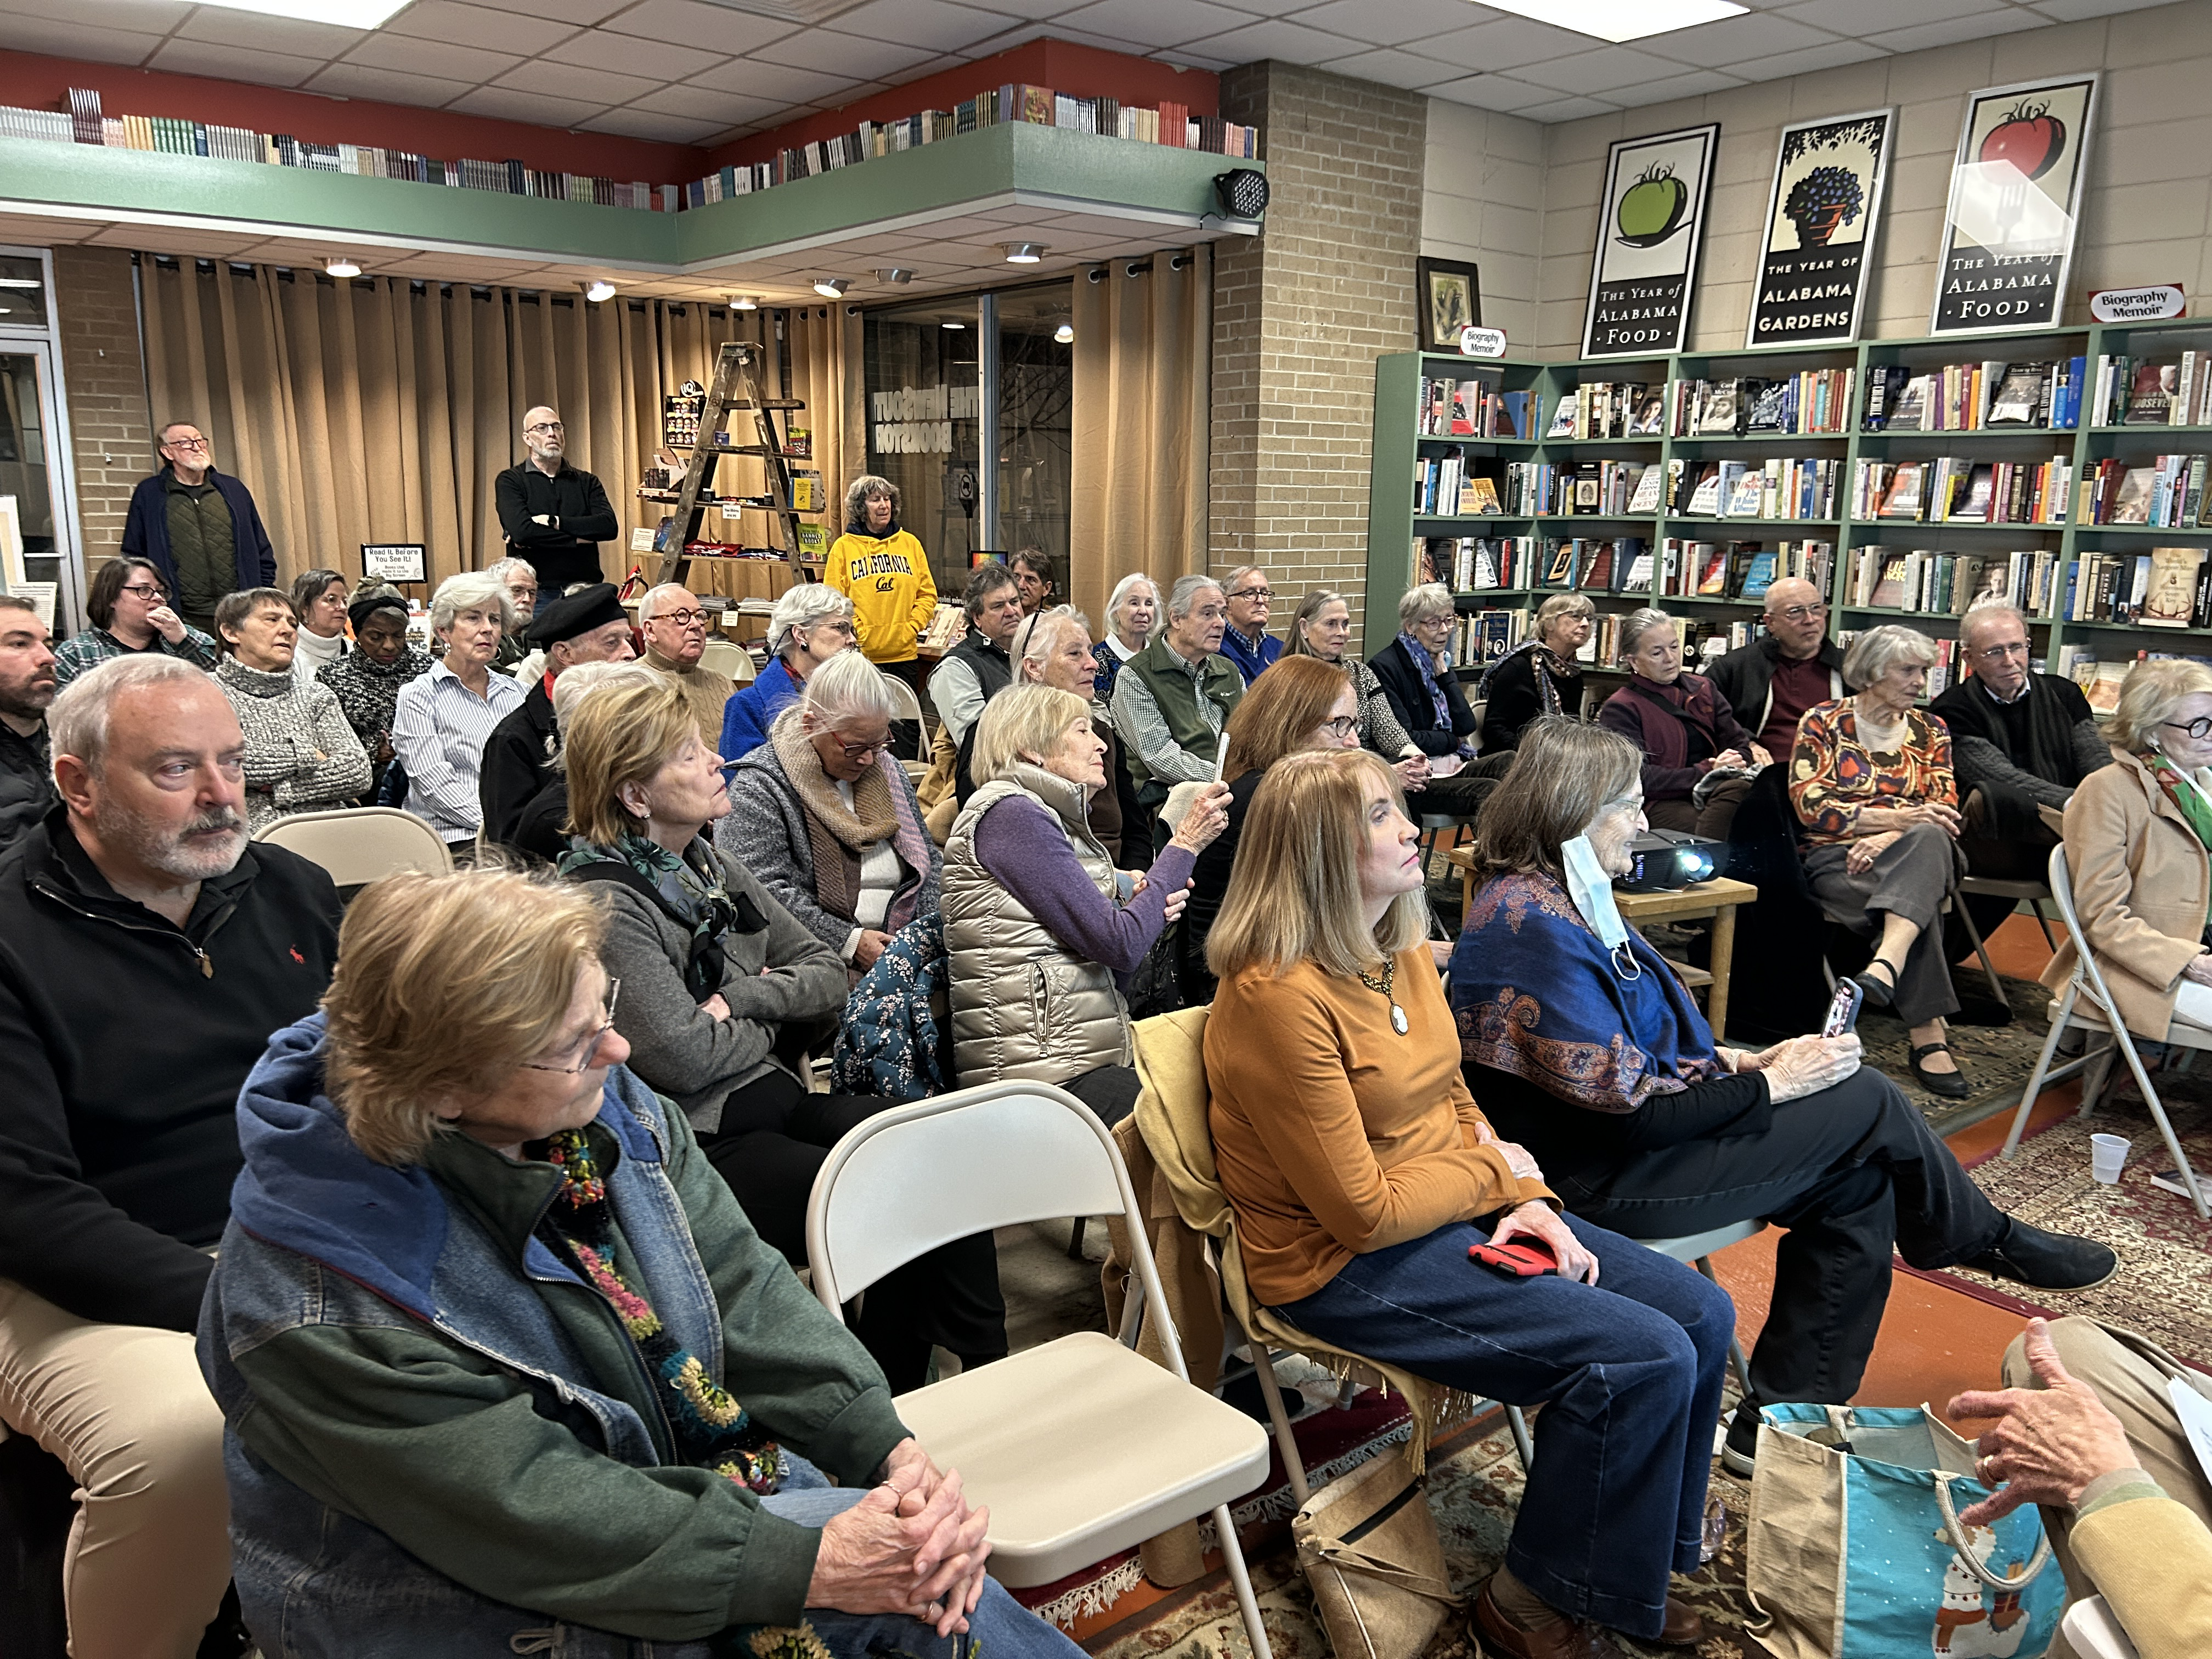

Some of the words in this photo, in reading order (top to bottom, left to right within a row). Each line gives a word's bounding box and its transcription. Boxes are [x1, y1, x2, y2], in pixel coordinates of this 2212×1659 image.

[1768, 264, 1792, 275] THE
[1799, 259, 1834, 272] YEAR
[1841, 257, 1859, 267] OF
[1953, 257, 1984, 272] THE
[1991, 253, 2034, 268] YEAR
[2040, 248, 2059, 268] of
[1600, 290, 1626, 303] THE
[1631, 286, 1663, 301] YEAR
[1668, 283, 1683, 299] of
[1762, 284, 1852, 303] ALABAMA
[1947, 273, 2053, 295] ALABAMA
[2102, 291, 2168, 308] Biography
[1597, 305, 1678, 324] ALABAMA
[1959, 300, 2030, 319] FOOD
[2113, 304, 2163, 318] Memoir
[1758, 311, 1849, 332] GARDENS
[1468, 331, 1499, 343] Biography
[1606, 328, 1661, 346] FOOD
[1470, 343, 1496, 353] Memoir
[851, 554, 912, 580] CALIFORNIA
[876, 577, 895, 592] Cal
